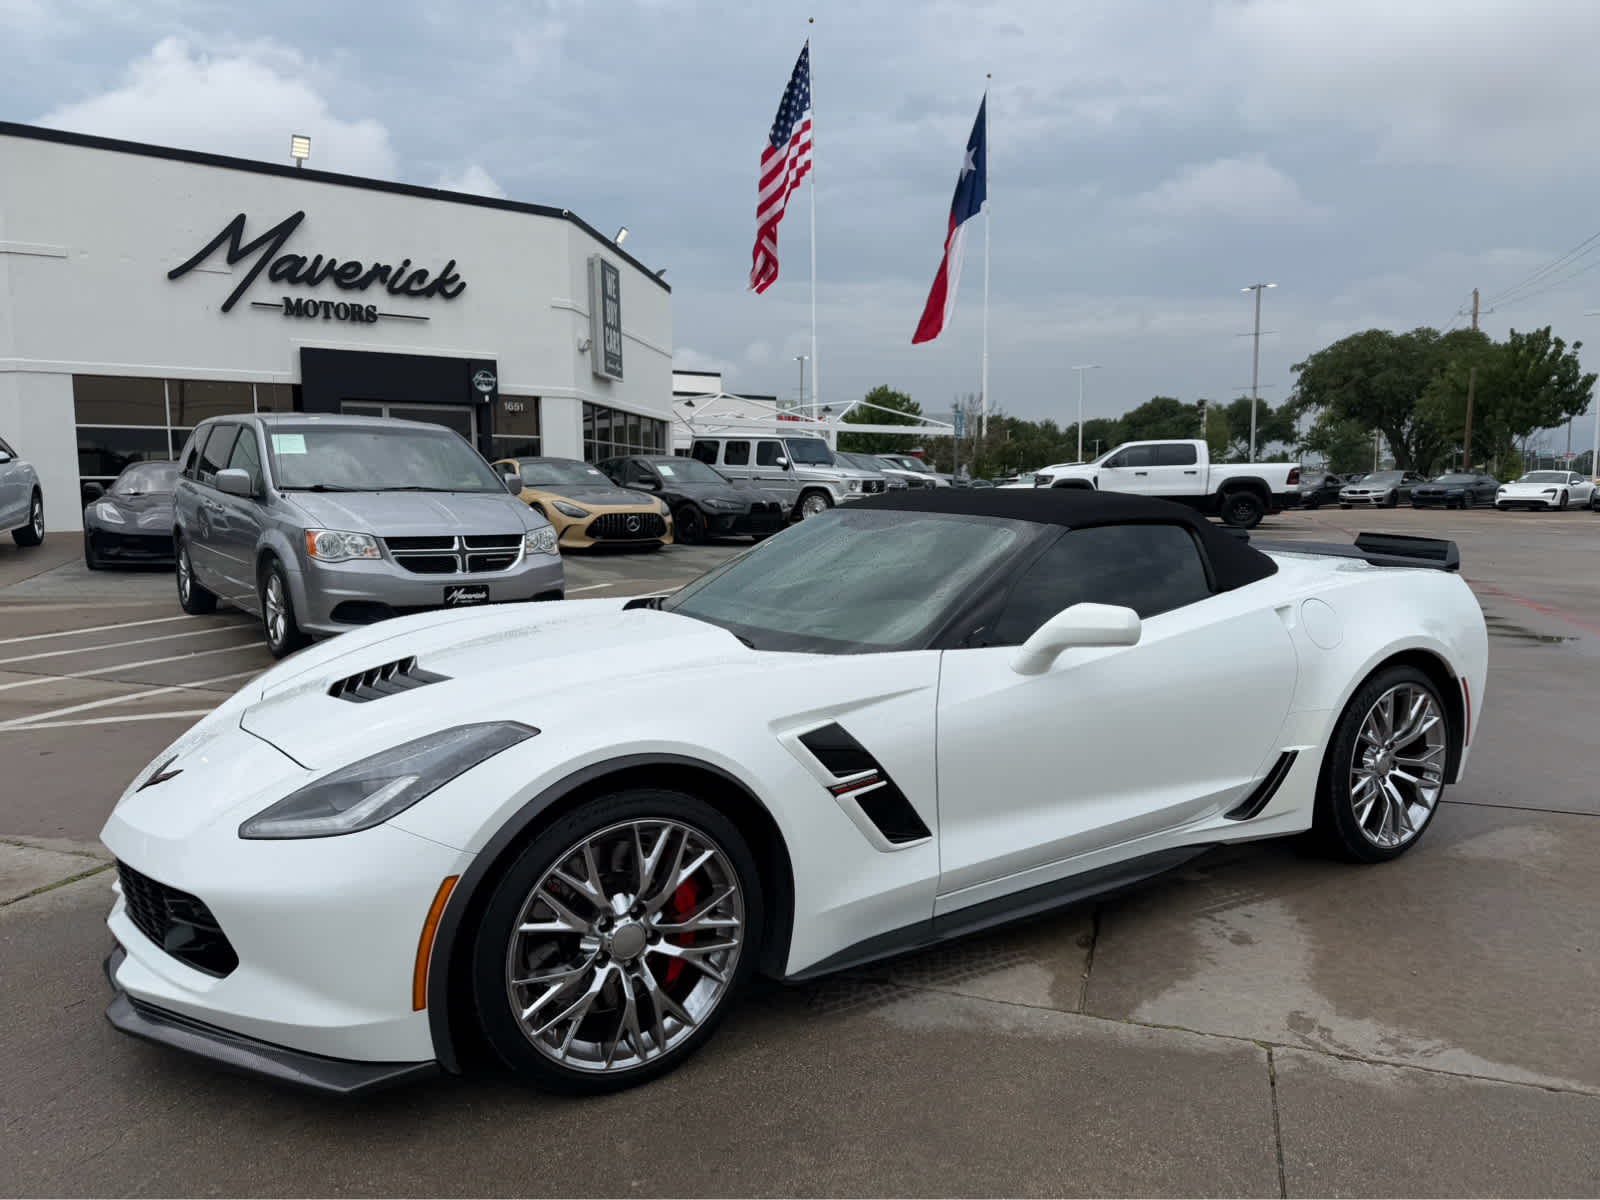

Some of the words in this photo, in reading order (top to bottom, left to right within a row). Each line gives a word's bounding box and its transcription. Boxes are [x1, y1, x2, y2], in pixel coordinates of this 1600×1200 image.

[168, 210, 467, 312] Maverick
[606, 270, 616, 299] WE
[283, 297, 378, 323] MOTORS
[606, 299, 618, 329] BUY
[605, 326, 621, 356] CARS
